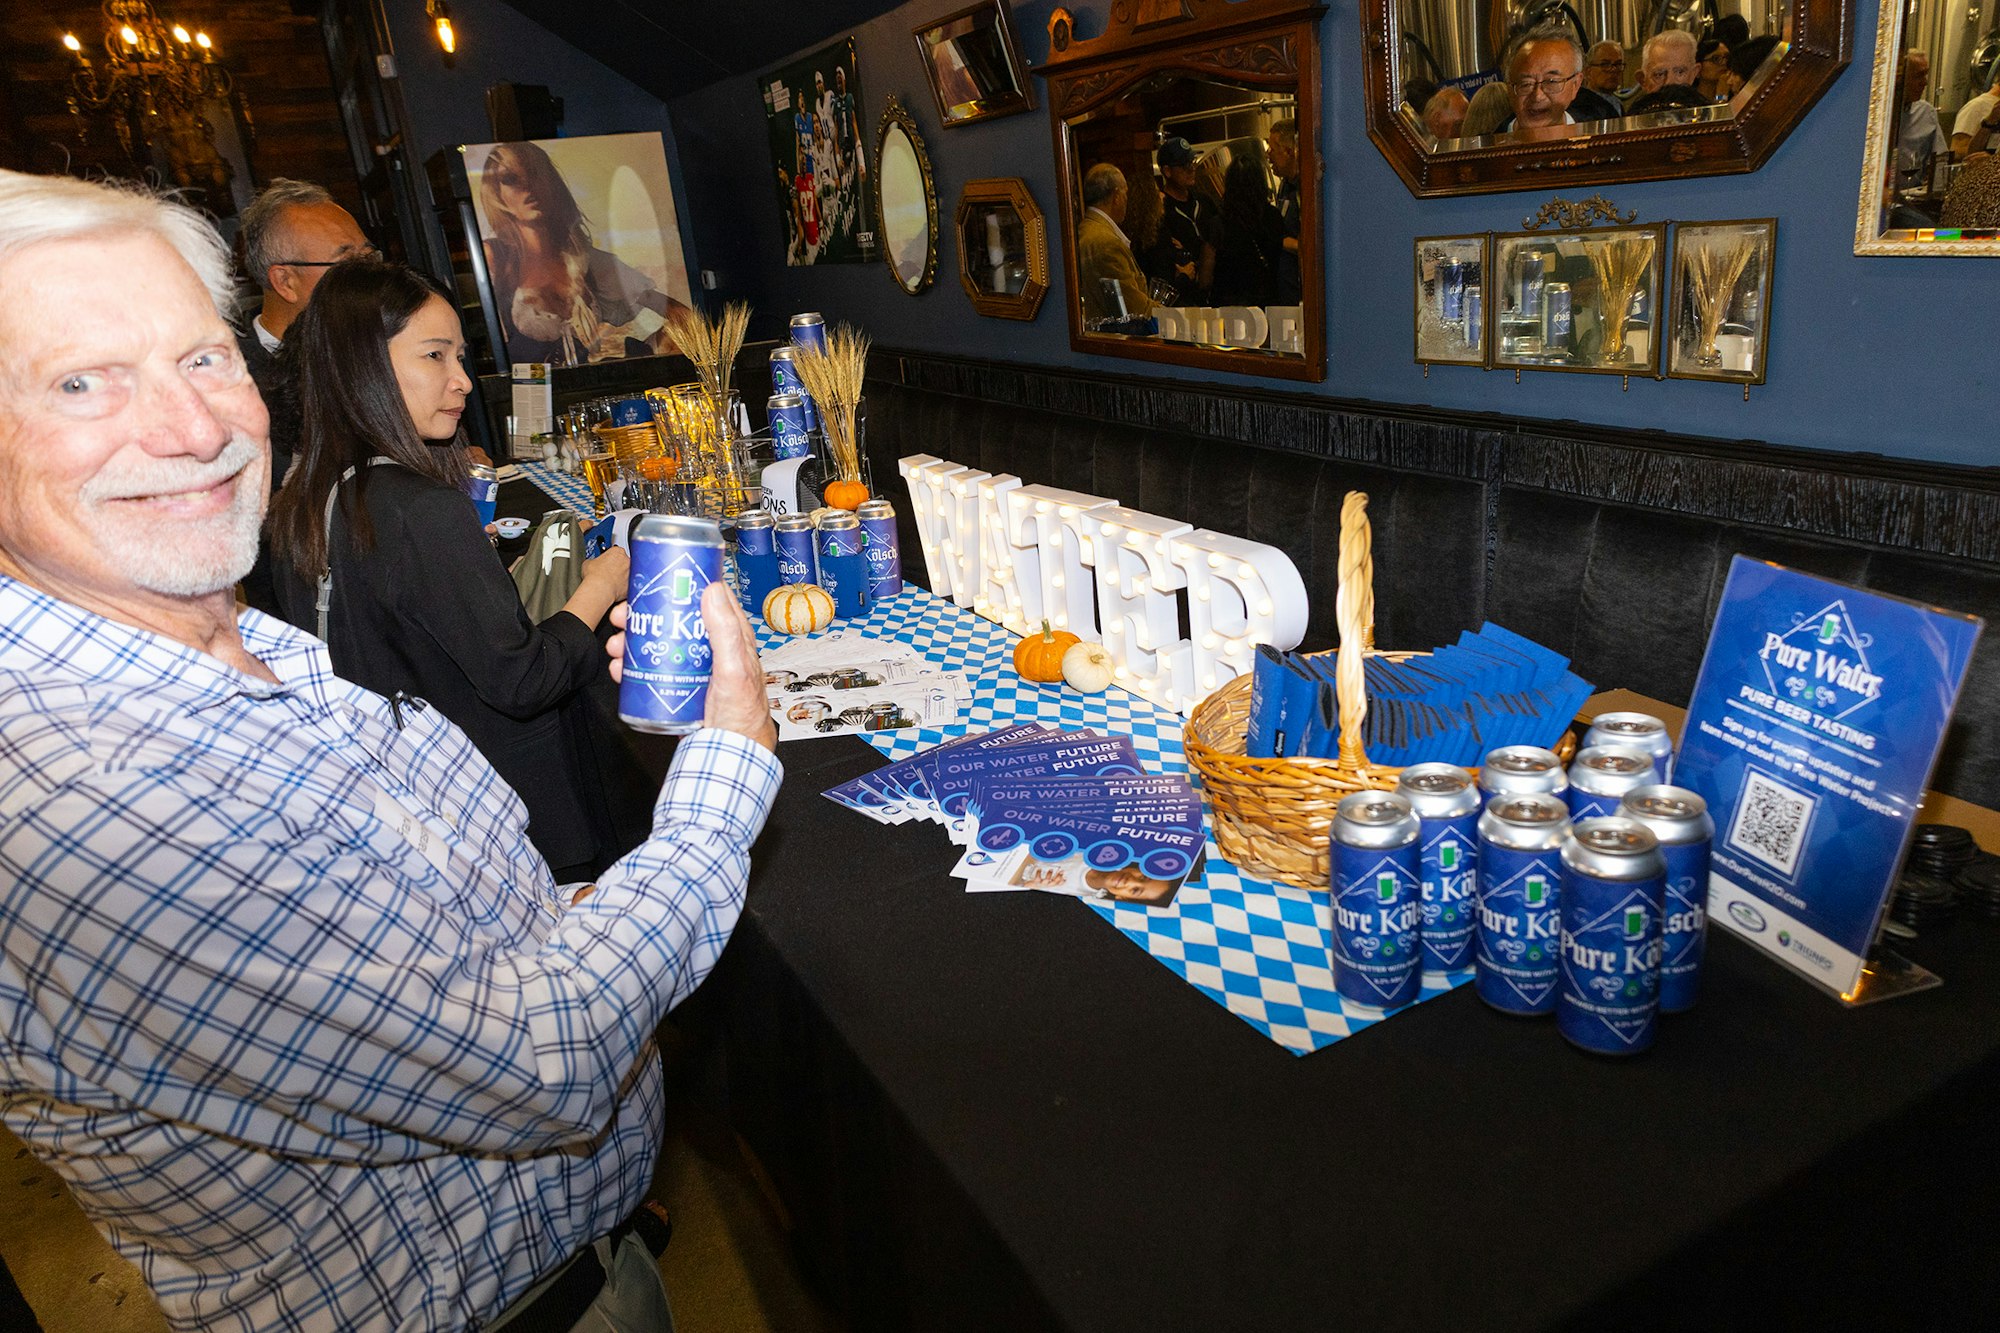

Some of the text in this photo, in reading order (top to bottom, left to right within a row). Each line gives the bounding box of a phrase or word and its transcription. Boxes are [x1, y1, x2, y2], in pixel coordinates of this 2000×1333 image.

[761, 494, 787, 516] ONS
[898, 453, 1309, 708] WATER
[670, 609, 710, 640] Kö
[644, 673, 674, 683] BETTER
[675, 675, 694, 683] WITH
[695, 675, 712, 683] PUR
[1758, 632, 1884, 697] Pure Water
[1739, 685, 1876, 750] PURE BEER TASTING
[979, 726, 1037, 750] FUTURE
[947, 741, 1123, 774] OUR WATER FUTURE
[1052, 751, 1121, 772] FUTURE
[1745, 743, 1775, 763] about
[1774, 755, 1792, 771] the
[1756, 731, 1773, 747] for
[1851, 775, 1877, 792] and
[991, 790, 1031, 801] OUR
[1037, 788, 1101, 799] WATER
[1108, 785, 1182, 797] FUTURE
[1003, 809, 1195, 847] OUR WATER FUTURE
[1440, 868, 1477, 903] Köl
[1525, 908, 1561, 940] Kö
[1560, 927, 1617, 974] Pure
